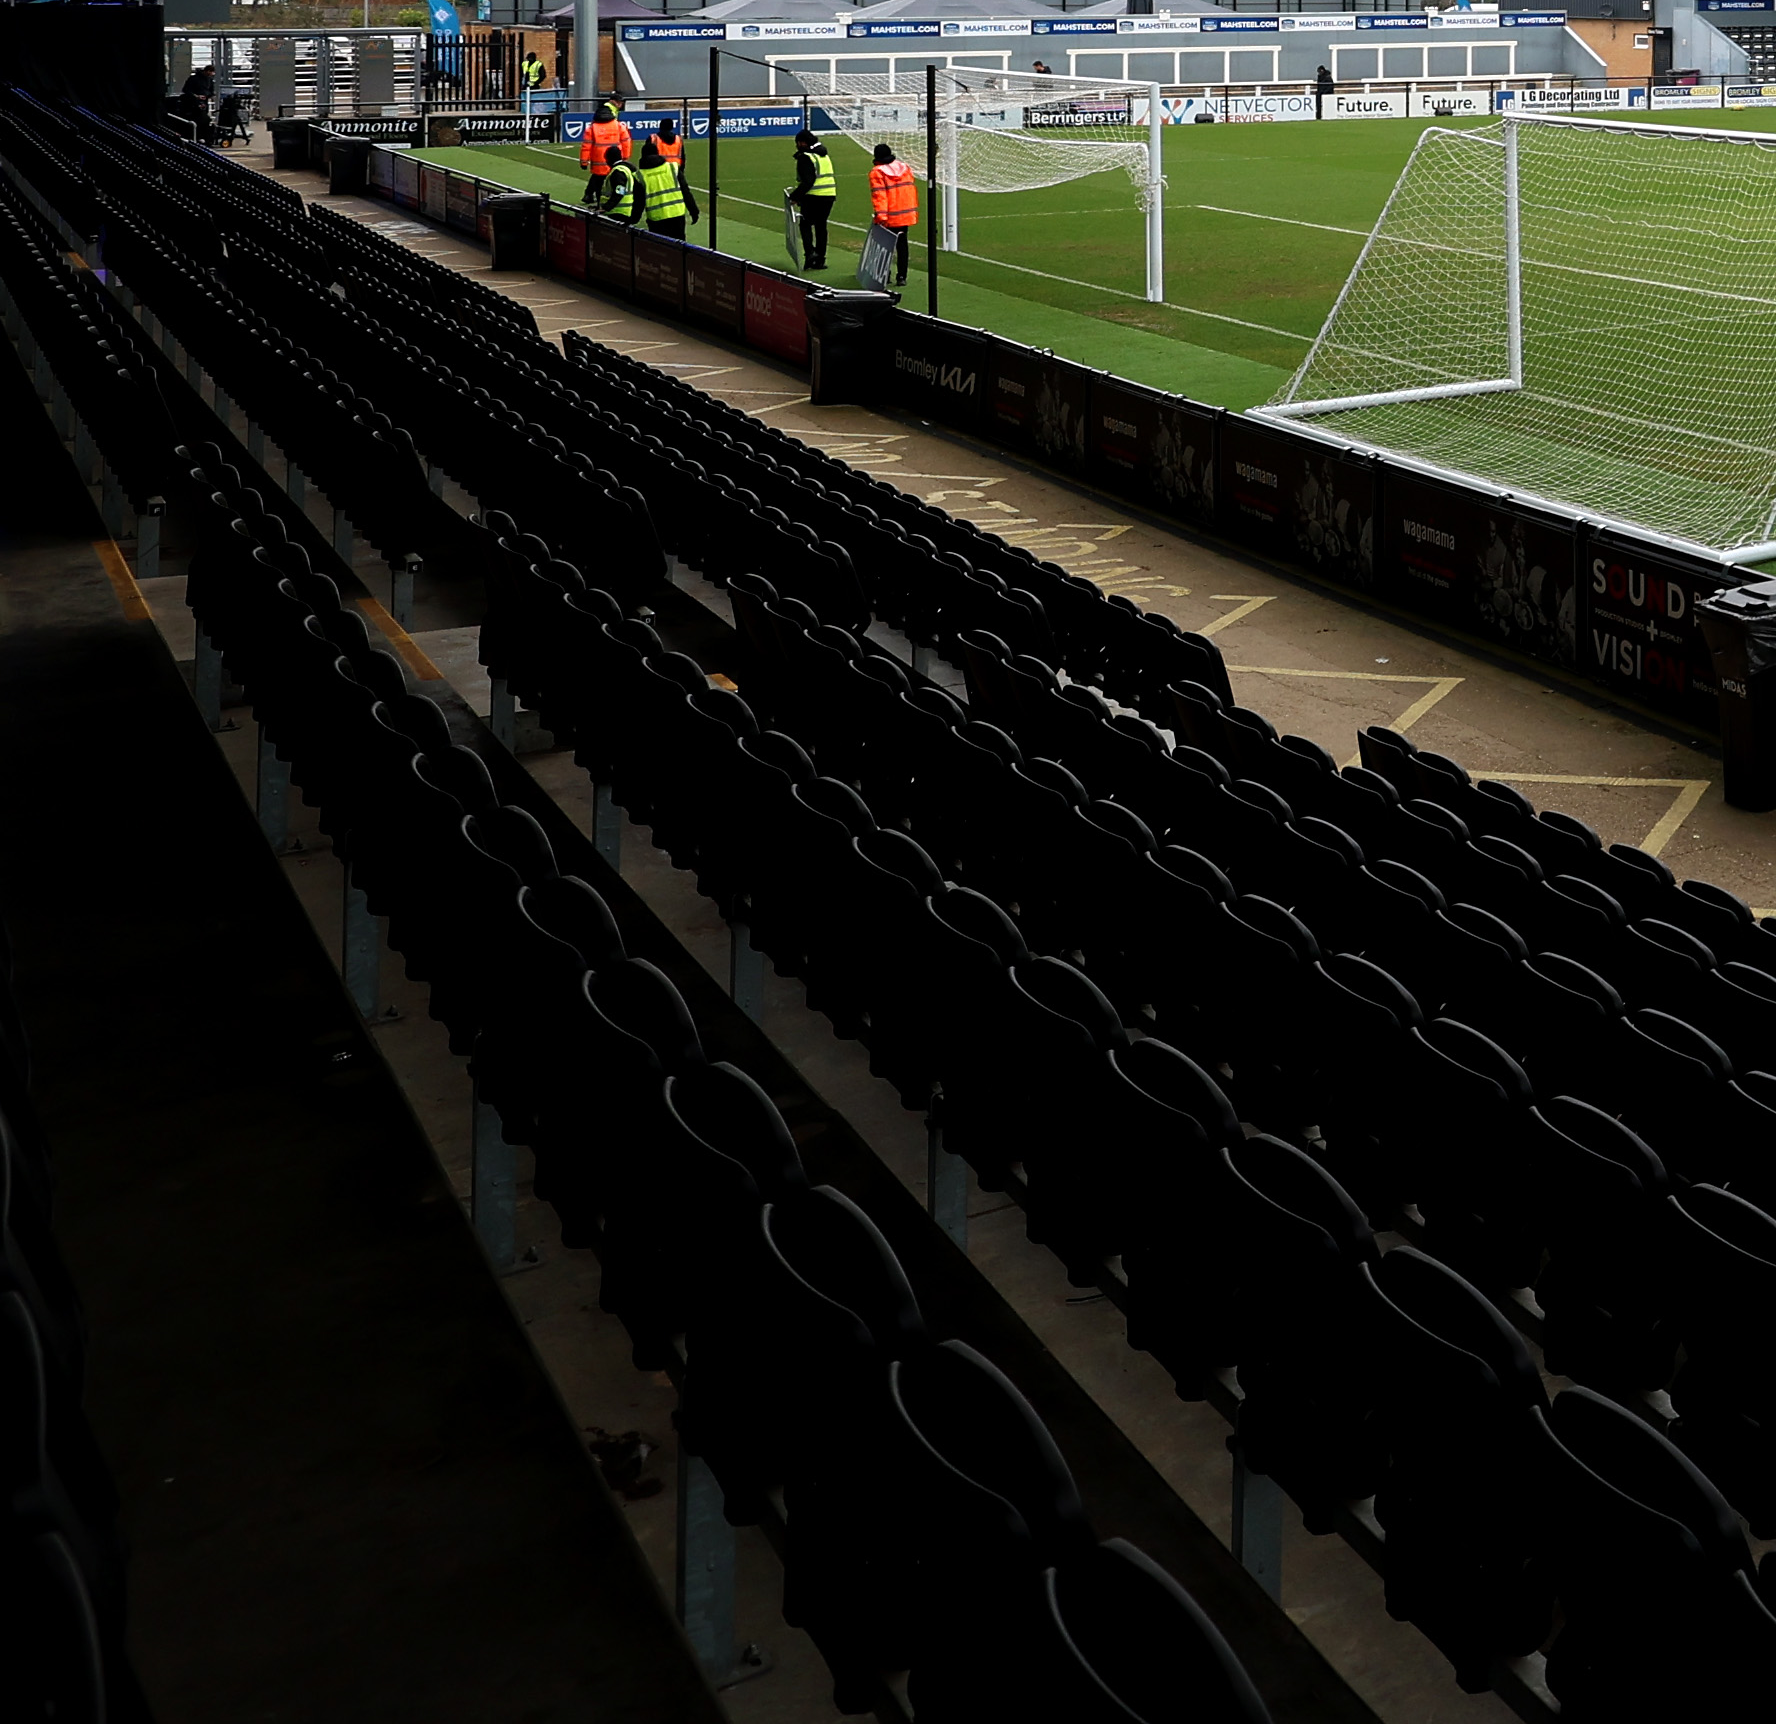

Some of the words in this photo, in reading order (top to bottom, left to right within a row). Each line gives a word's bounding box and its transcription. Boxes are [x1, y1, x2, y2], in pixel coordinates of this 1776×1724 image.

[963, 22, 1030, 34] MAHSTEEL.COM
[1053, 21, 1116, 32] MAHSTEEL.COM
[1137, 20, 1199, 31] MAHSTEEL.COM
[1220, 19, 1278, 29] MAHSTEEL.COM
[1373, 17, 1427, 27] MAHSTEEL.COM
[649, 27, 725, 39] MAHSTEEL.COM
[764, 25, 836, 36] MAHSTEEL.COM
[870, 24, 940, 34] MAHSTEEL.COM
[1603, 88, 1620, 100] Ltd
[1203, 97, 1314, 114] NETVECTOR
[1336, 96, 1393, 113] Future.
[453, 117, 550, 130] Ammonite
[759, 116, 800, 126] STREET
[1030, 110, 1105, 127] Berringers
[320, 119, 418, 133] Ammonite
[895, 348, 938, 386] Bromley
[1102, 413, 1137, 439] wagamama
[1235, 459, 1278, 489] wagamama
[1402, 517, 1455, 551] wagamama
[1592, 558, 1686, 620] SOUND
[1592, 628, 1687, 696] VISION
[1721, 676, 1748, 700] MIDAS
